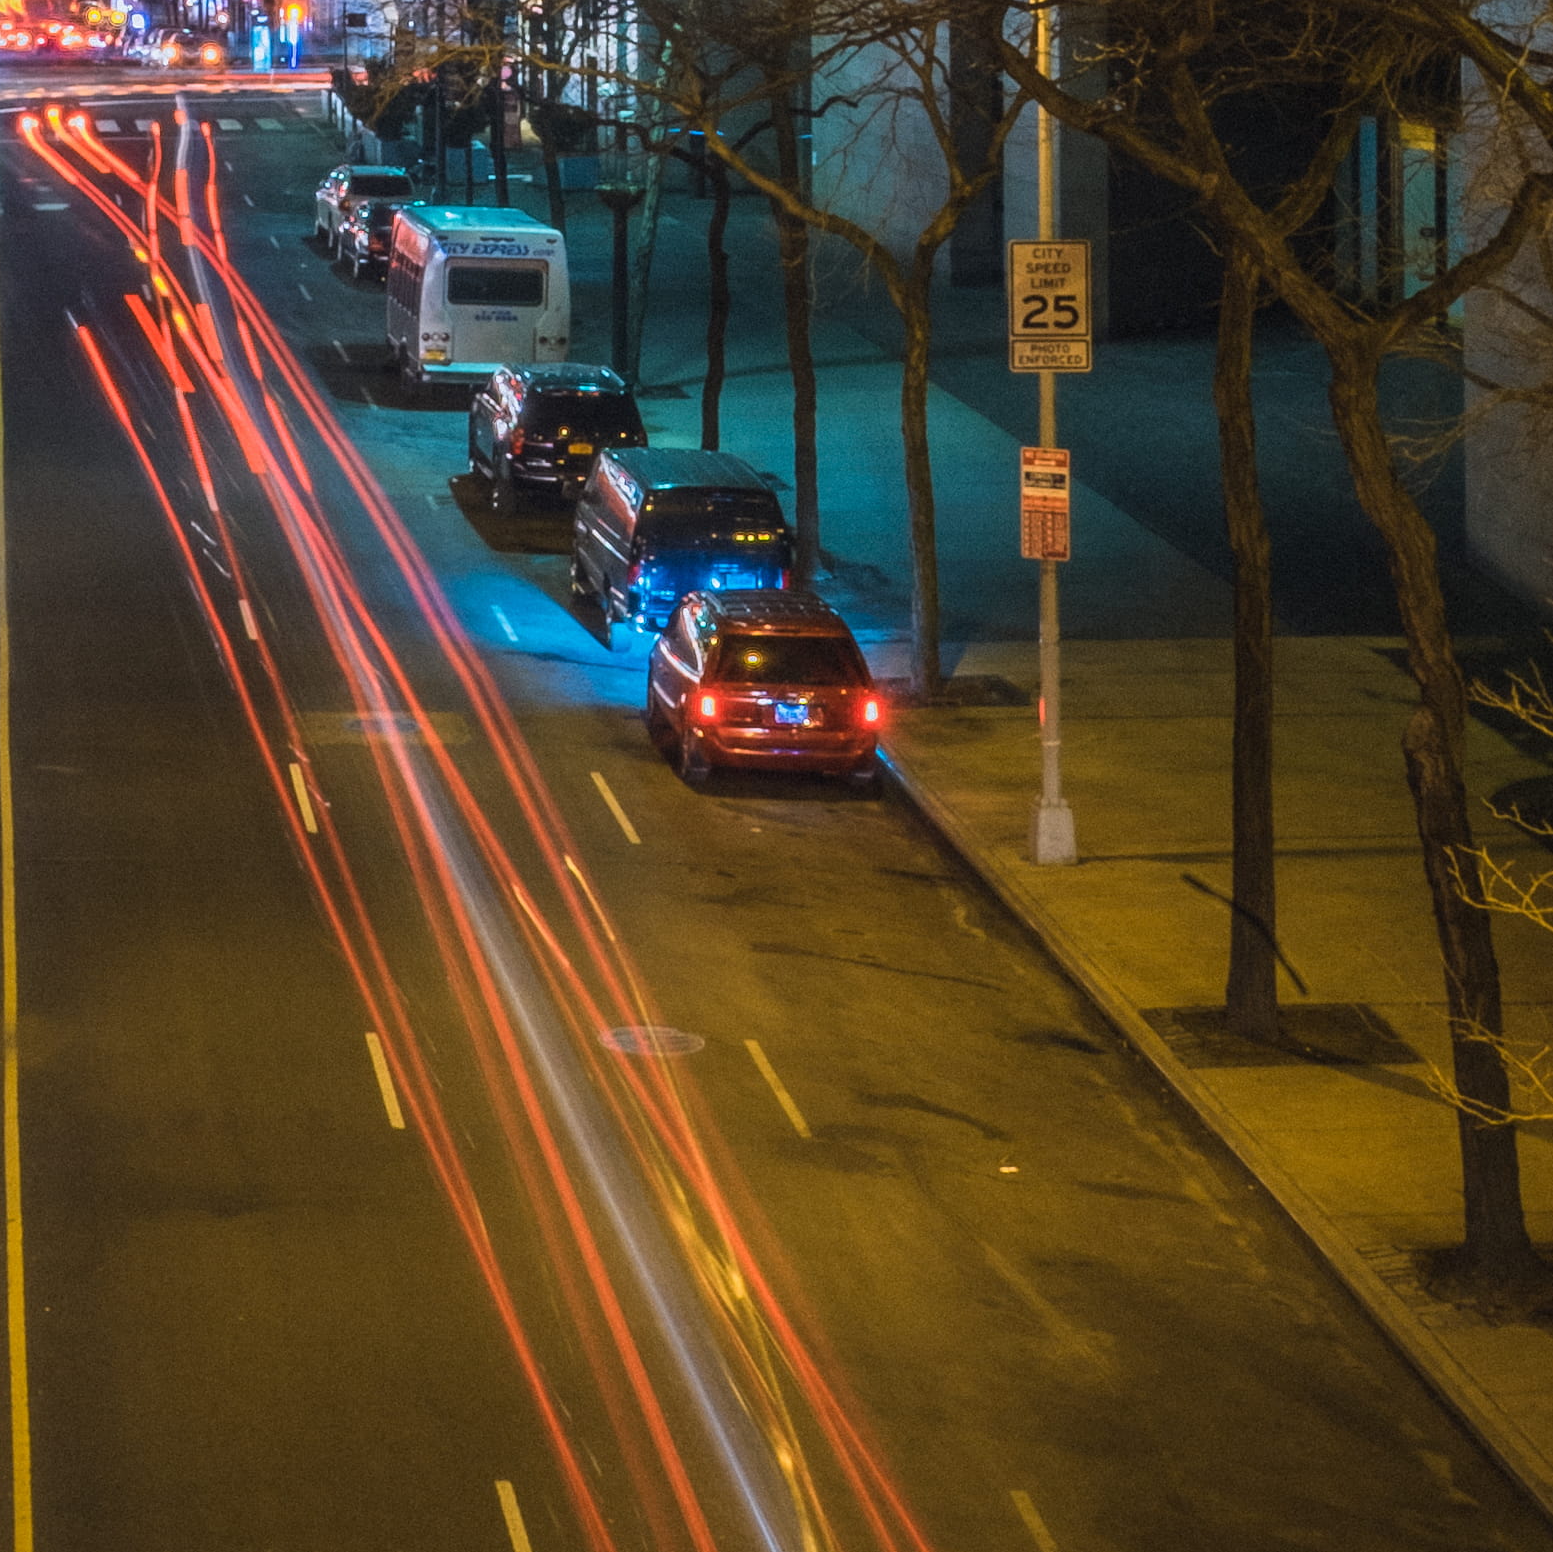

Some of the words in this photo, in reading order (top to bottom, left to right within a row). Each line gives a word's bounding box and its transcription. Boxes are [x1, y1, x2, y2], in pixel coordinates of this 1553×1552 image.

[472, 243, 530, 256] EXPRESS
[1032, 247, 1063, 259] CITY
[1026, 262, 1071, 274] SPEED
[1030, 277, 1066, 289] LIMIT
[1022, 294, 1079, 329] 25
[1030, 343, 1070, 354] PHOTO
[1018, 354, 1082, 365] ENFORCED
